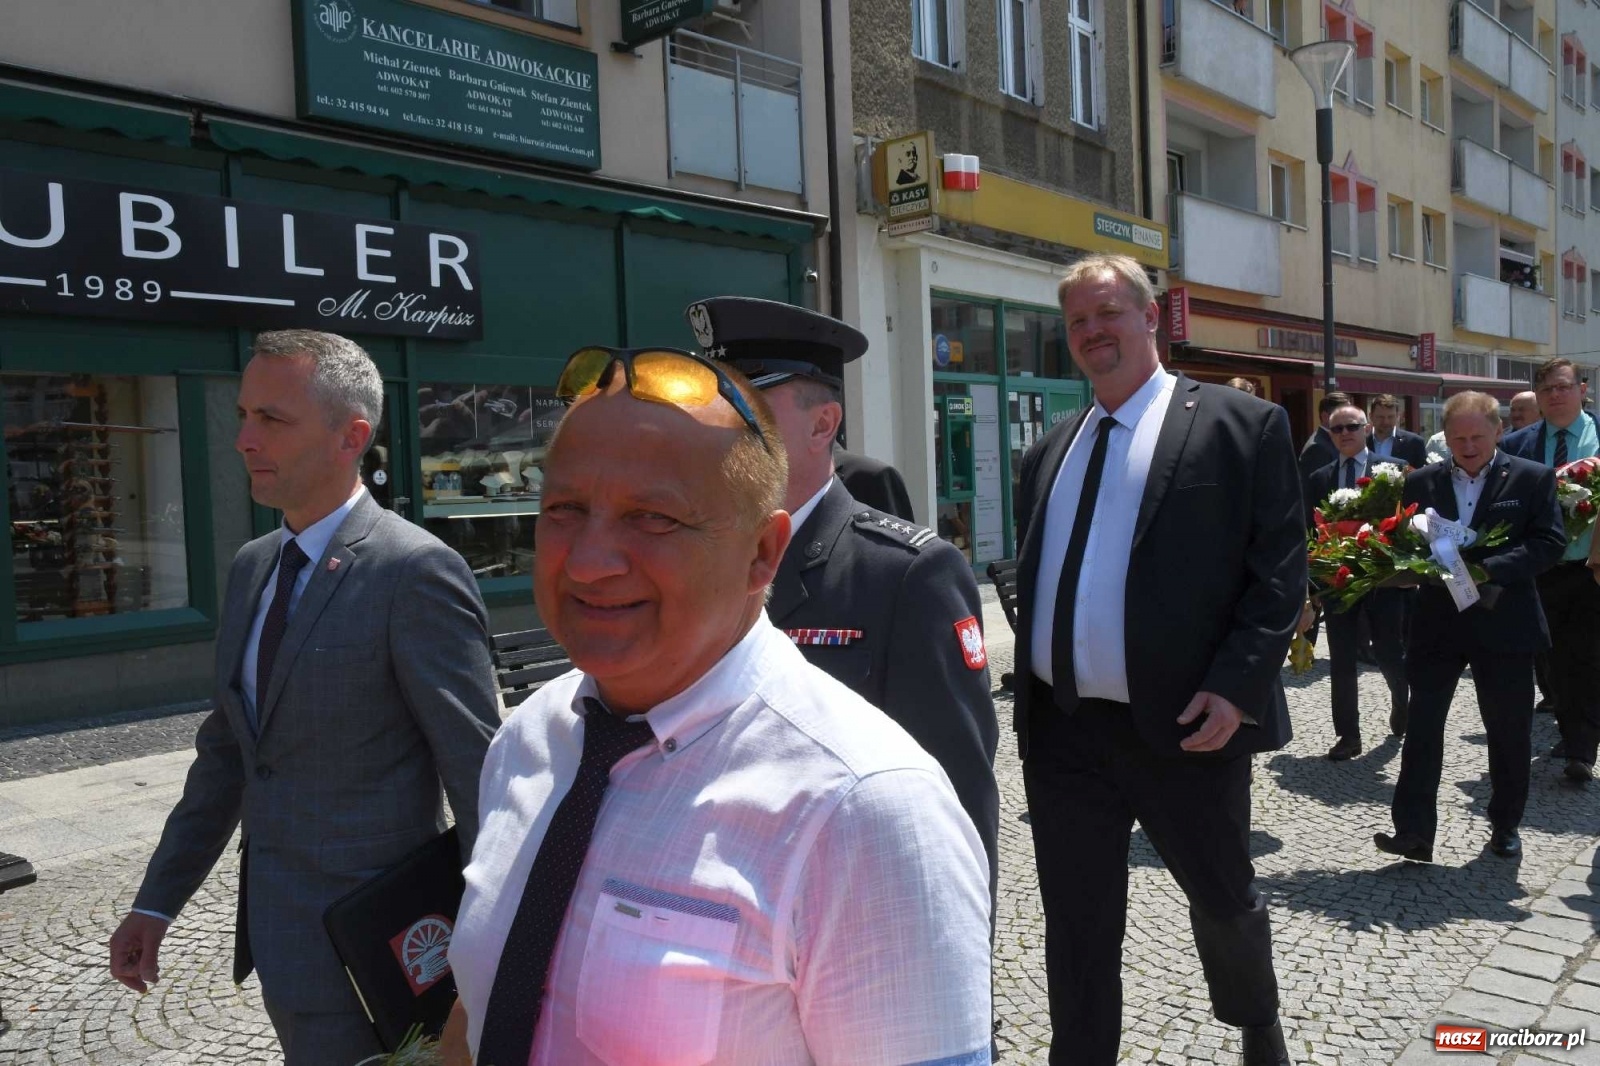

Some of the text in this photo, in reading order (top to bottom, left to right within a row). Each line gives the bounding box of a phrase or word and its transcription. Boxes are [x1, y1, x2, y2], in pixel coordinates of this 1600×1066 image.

[632, 6, 660, 23] Barbara
[644, 9, 680, 29] ADWOKAT
[362, 17, 481, 61] KANCELARIE
[485, 48, 592, 89] ADWOKACKIE
[402, 59, 442, 77] Zientek
[376, 71, 431, 89] ADWOKAT
[449, 69, 527, 98] Barbara Gniewek
[336, 98, 347, 109] 32
[349, 101, 365, 112] 415
[366, 104, 377, 114] 94
[379, 107, 389, 116] 94
[465, 89, 513, 108] ADWOKAT
[531, 89, 592, 112] Stefan Zientek
[540, 107, 585, 123] ADWOKAT
[435, 118, 446, 128] 32
[447, 121, 462, 131] 418
[464, 123, 473, 133] 15
[474, 126, 484, 135] 30
[902, 187, 926, 201] KASY
[1097, 217, 1131, 239] STEFCZYK
[56, 272, 162, 303] 1989
[317, 288, 475, 334] M. Karpisz
